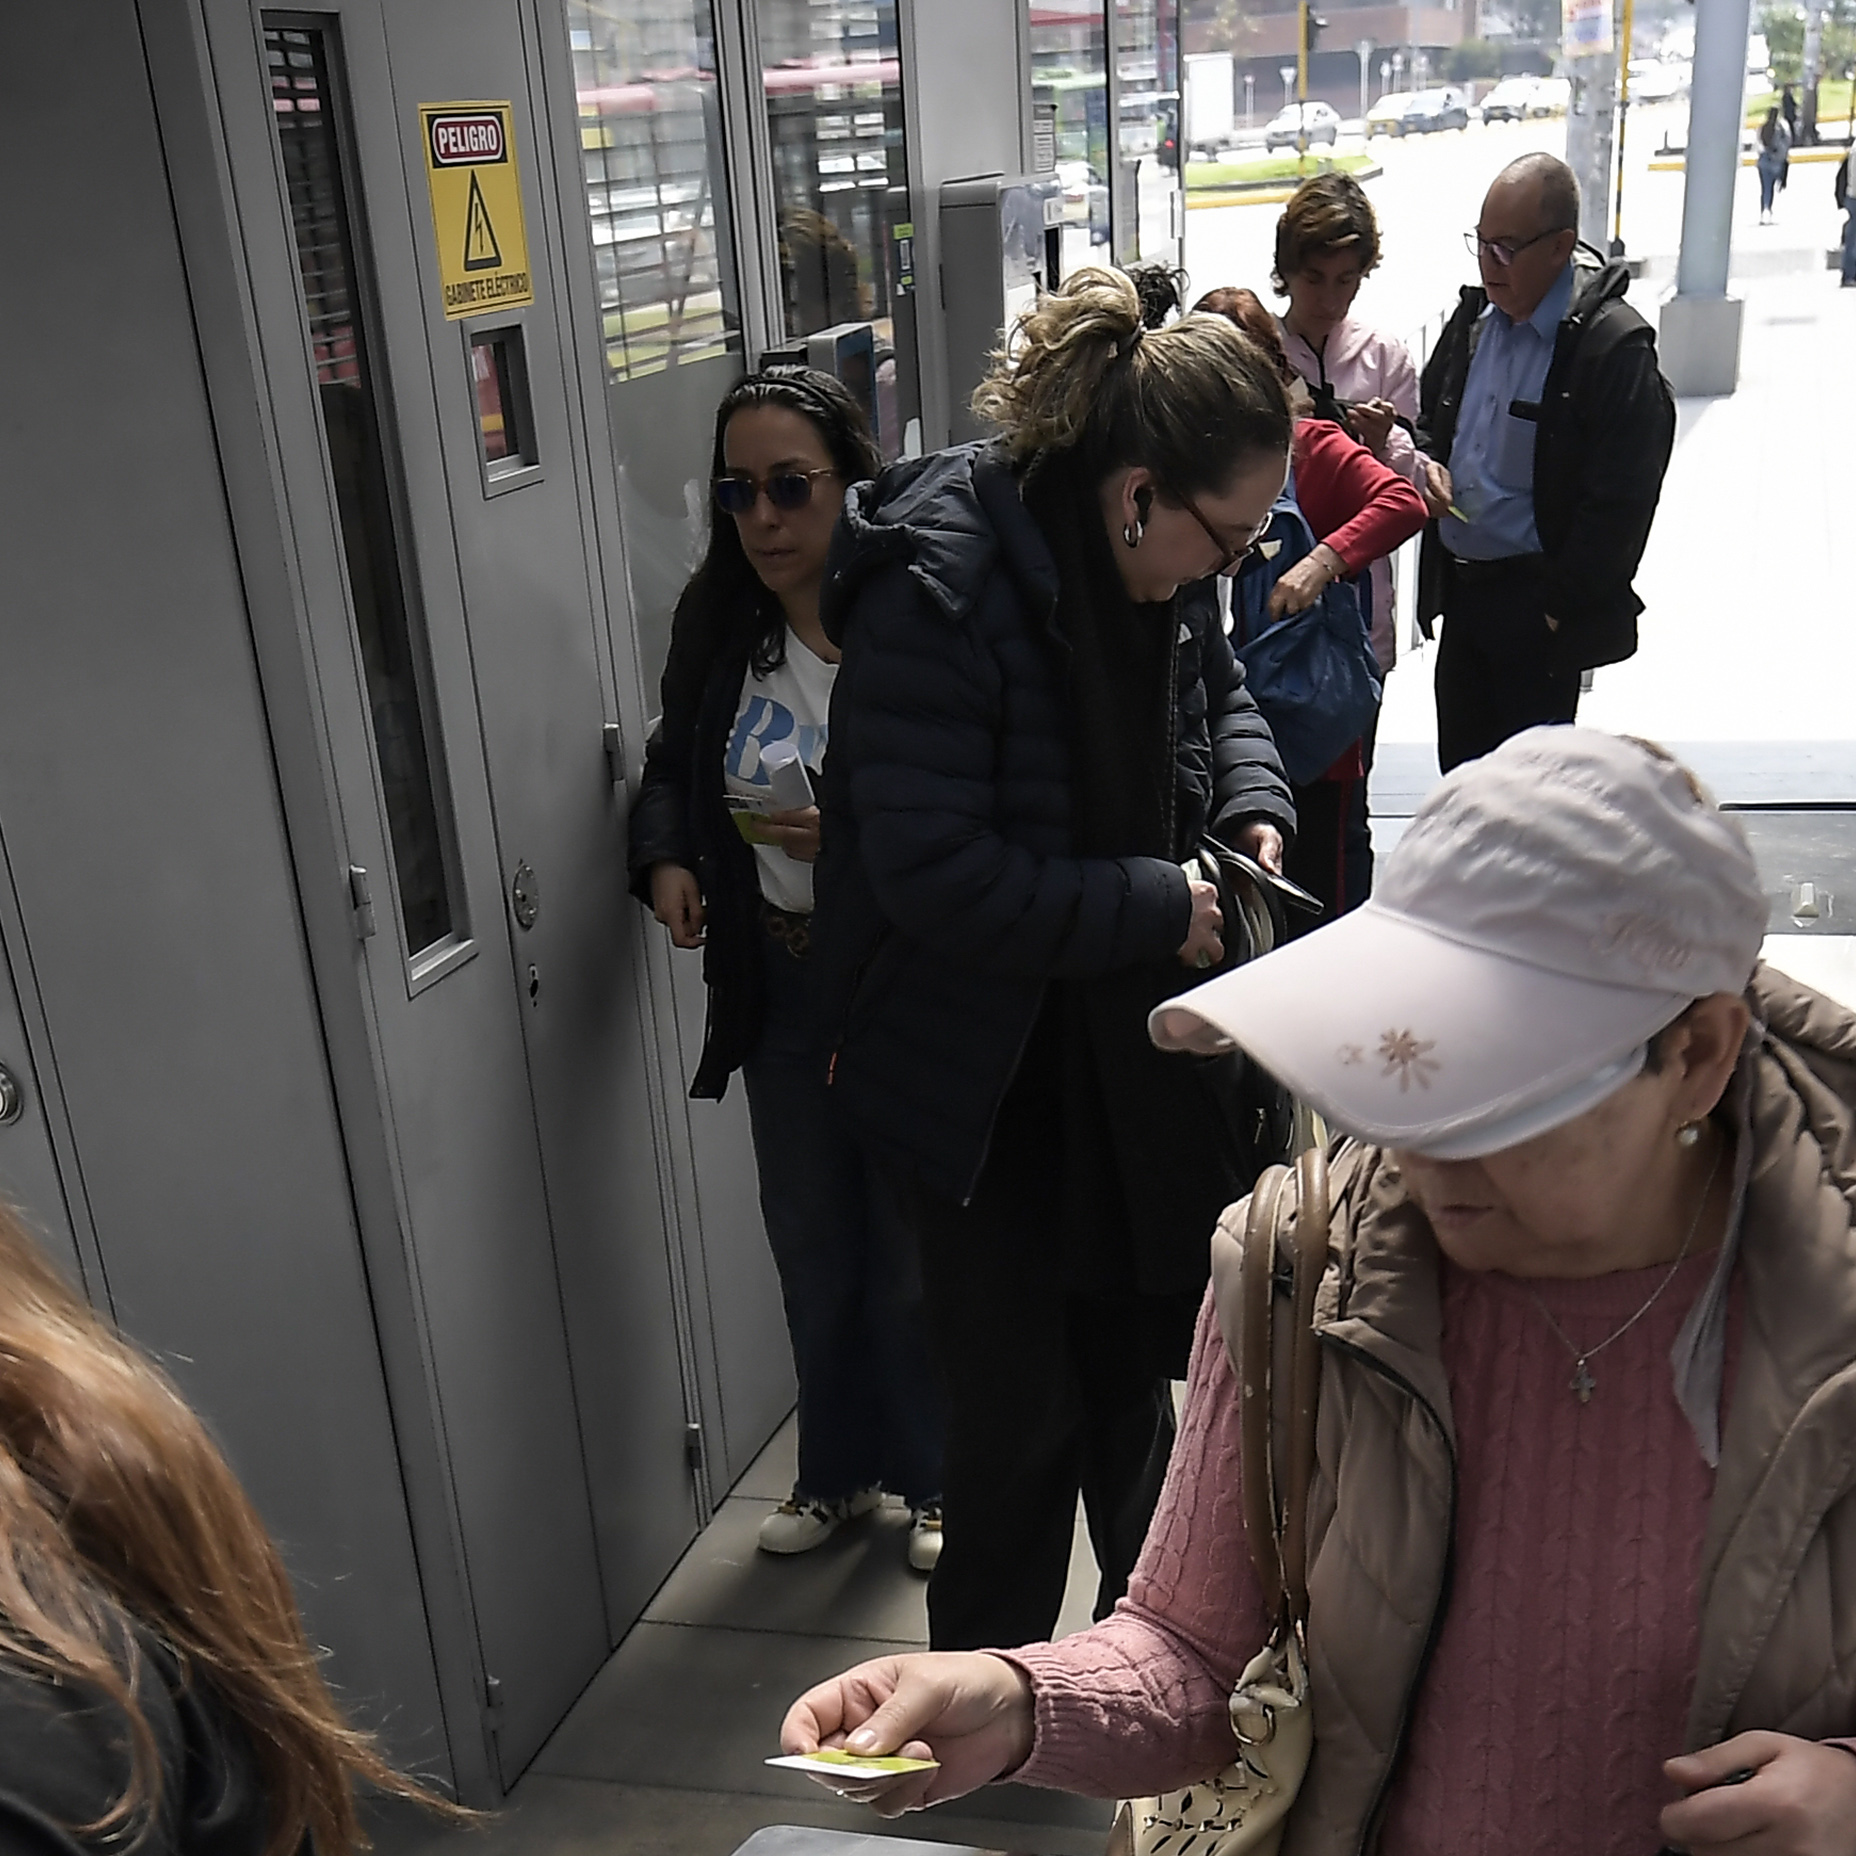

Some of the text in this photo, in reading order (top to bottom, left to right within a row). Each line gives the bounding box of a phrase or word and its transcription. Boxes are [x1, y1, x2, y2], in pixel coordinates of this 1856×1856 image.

[437, 124, 498, 154] PELIGRO
[445, 270, 528, 307] GABINETE ELÉCTRICO
